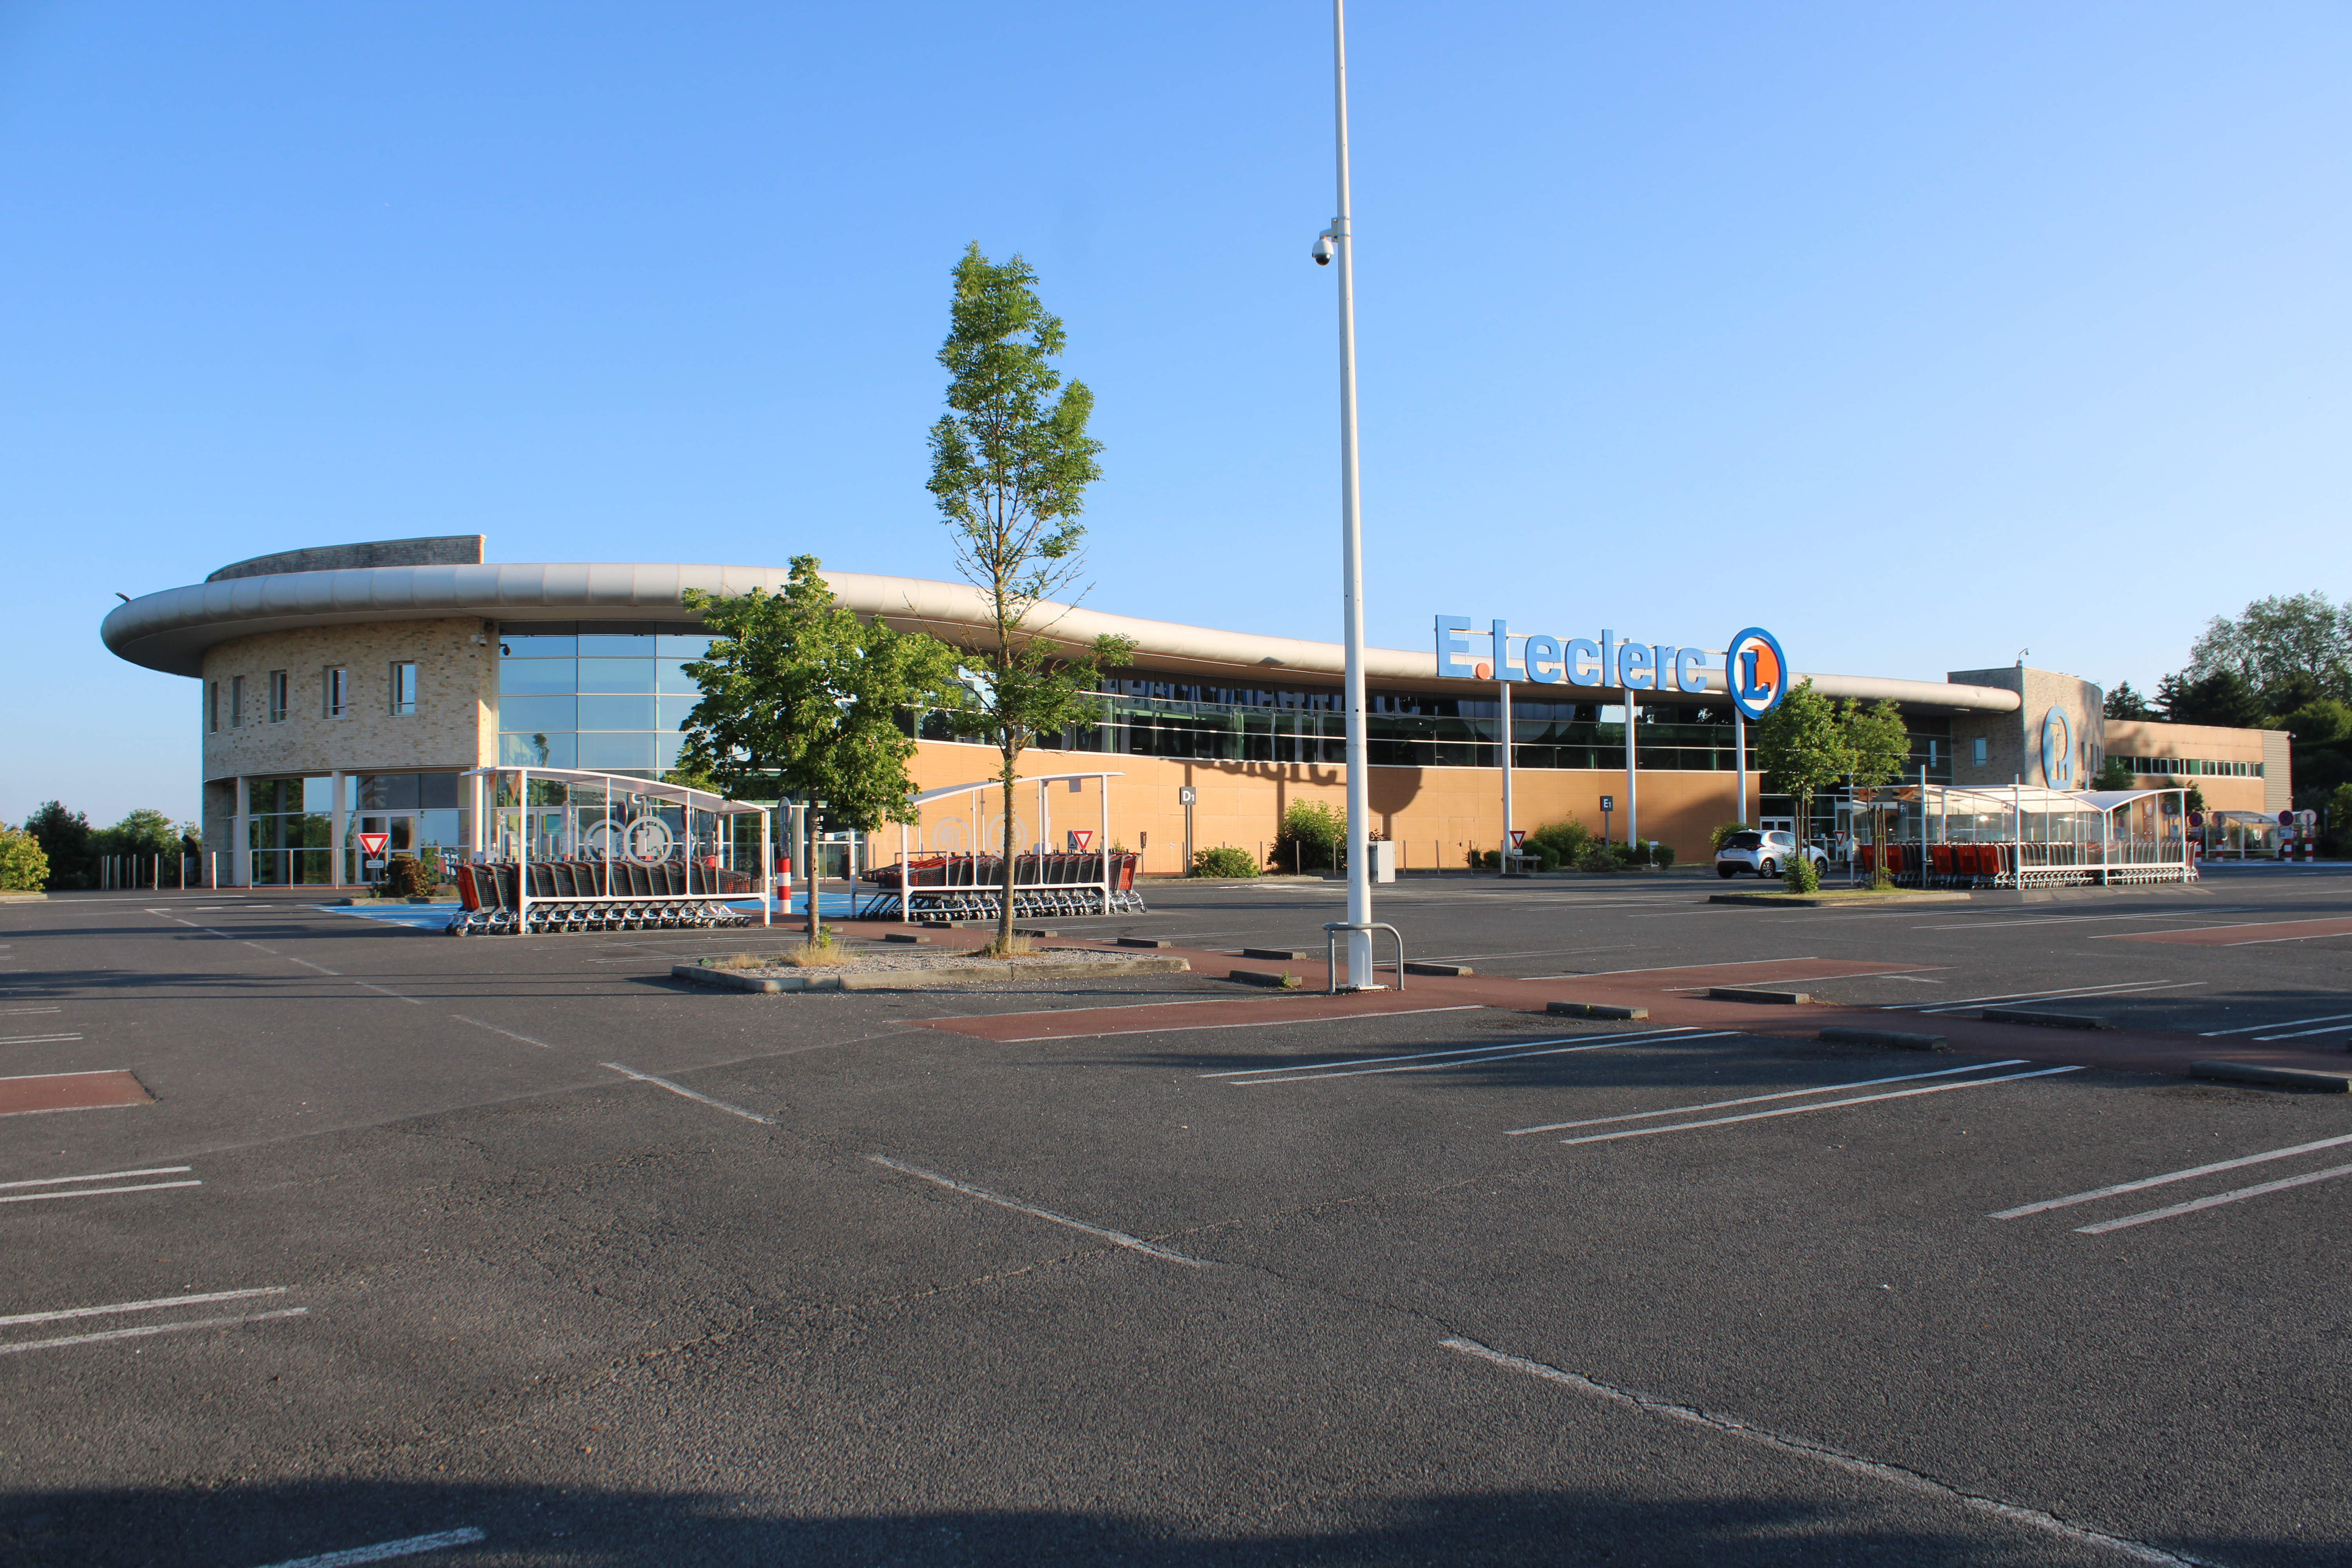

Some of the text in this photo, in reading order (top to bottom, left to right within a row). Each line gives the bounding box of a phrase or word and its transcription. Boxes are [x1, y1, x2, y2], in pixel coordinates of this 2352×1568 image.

[1435, 614, 1707, 693] E.Leclerc
[1740, 649, 1771, 700] L
[1183, 790, 1194, 802] D1
[1603, 799, 1611, 808] E1
